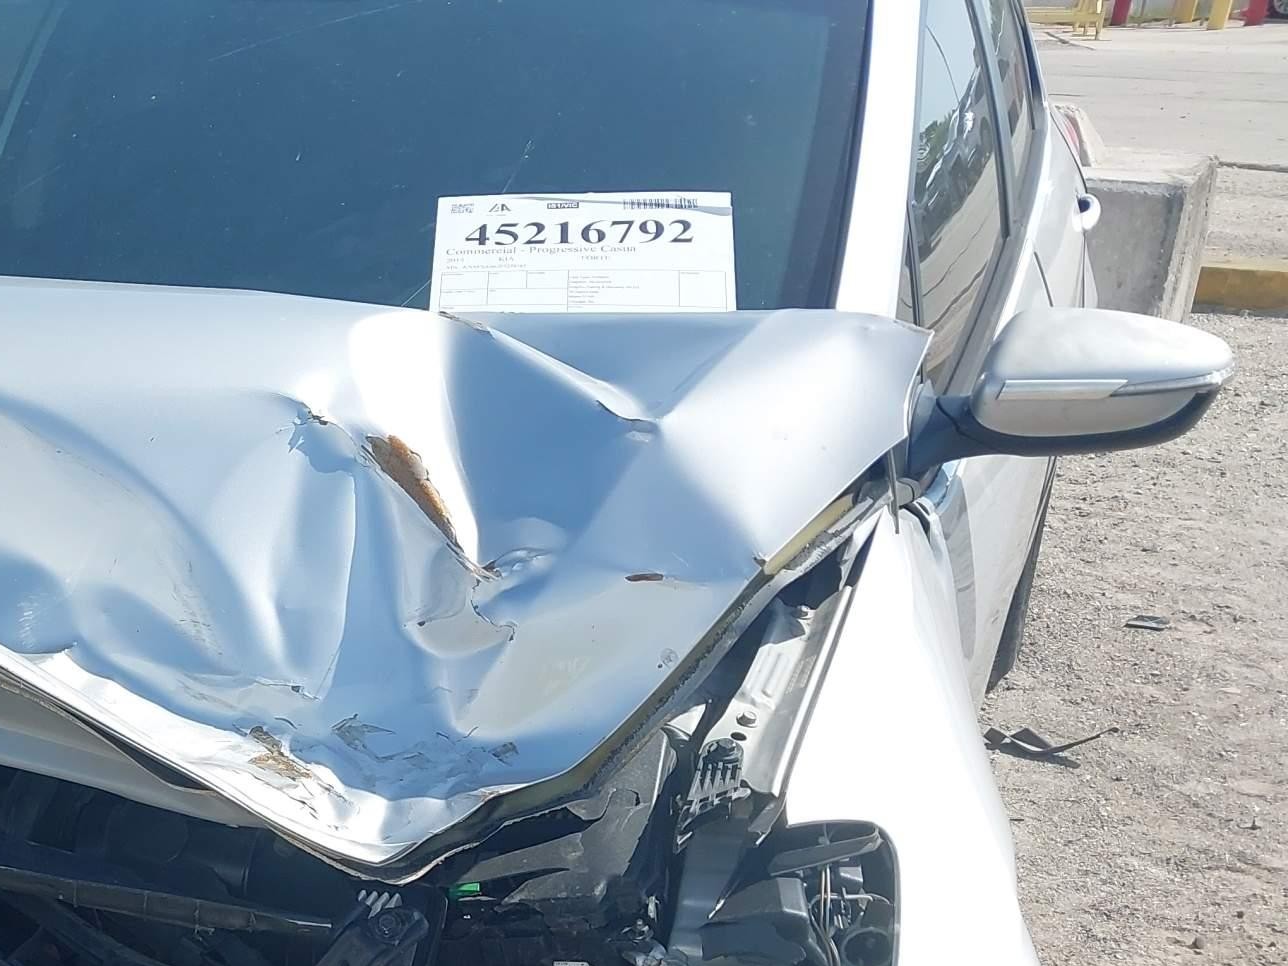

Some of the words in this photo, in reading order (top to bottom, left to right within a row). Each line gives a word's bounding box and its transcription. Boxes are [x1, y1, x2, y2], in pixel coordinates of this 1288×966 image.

[465, 219, 694, 246] 45216792
[446, 246, 516, 256] Commercial
[529, 244, 597, 255] Progressive
